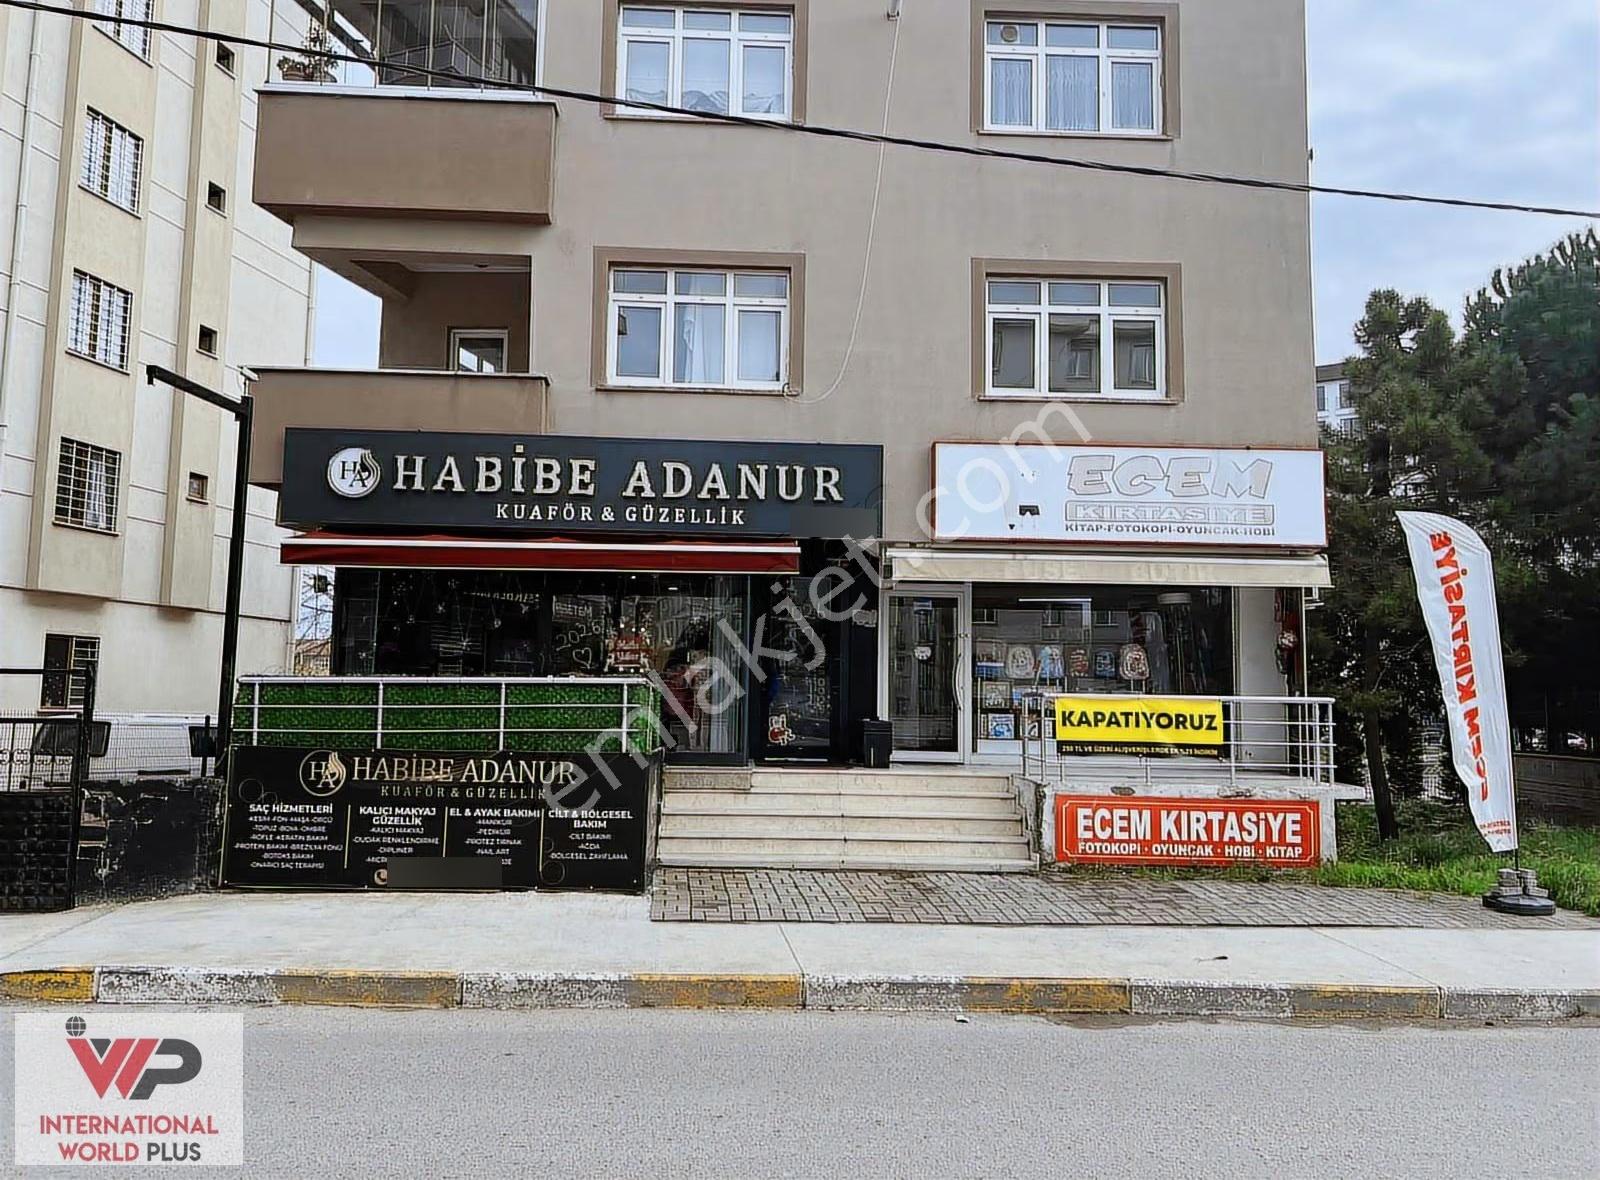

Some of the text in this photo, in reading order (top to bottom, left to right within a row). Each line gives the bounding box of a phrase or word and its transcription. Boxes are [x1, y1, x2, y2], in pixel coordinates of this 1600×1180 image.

[393, 445, 843, 501] HABİBE ADANUR
[1067, 455, 1273, 499] ECEM
[496, 503, 745, 525] KUAFÖR & GÜZELLİK
[1061, 709, 1218, 731] KAPATIYORUZ
[352, 753, 577, 785] HABİBE ADANUR
[381, 784, 445, 798] KUAFÖR
[451, 786, 459, 798] &
[249, 802, 333, 815] SAÇ HİZMETLERİ
[359, 806, 436, 816] KALICI MAKYAJ
[449, 808, 540, 818] EL & AYAK BAKIMI
[548, 808, 570, 818] CİLT
[373, 815, 422, 825] GÜZELLİK
[574, 820, 607, 829] BAKIM
[1076, 807, 1151, 840] ECEM
[1152, 843, 1214, 856] OYUNCAK
